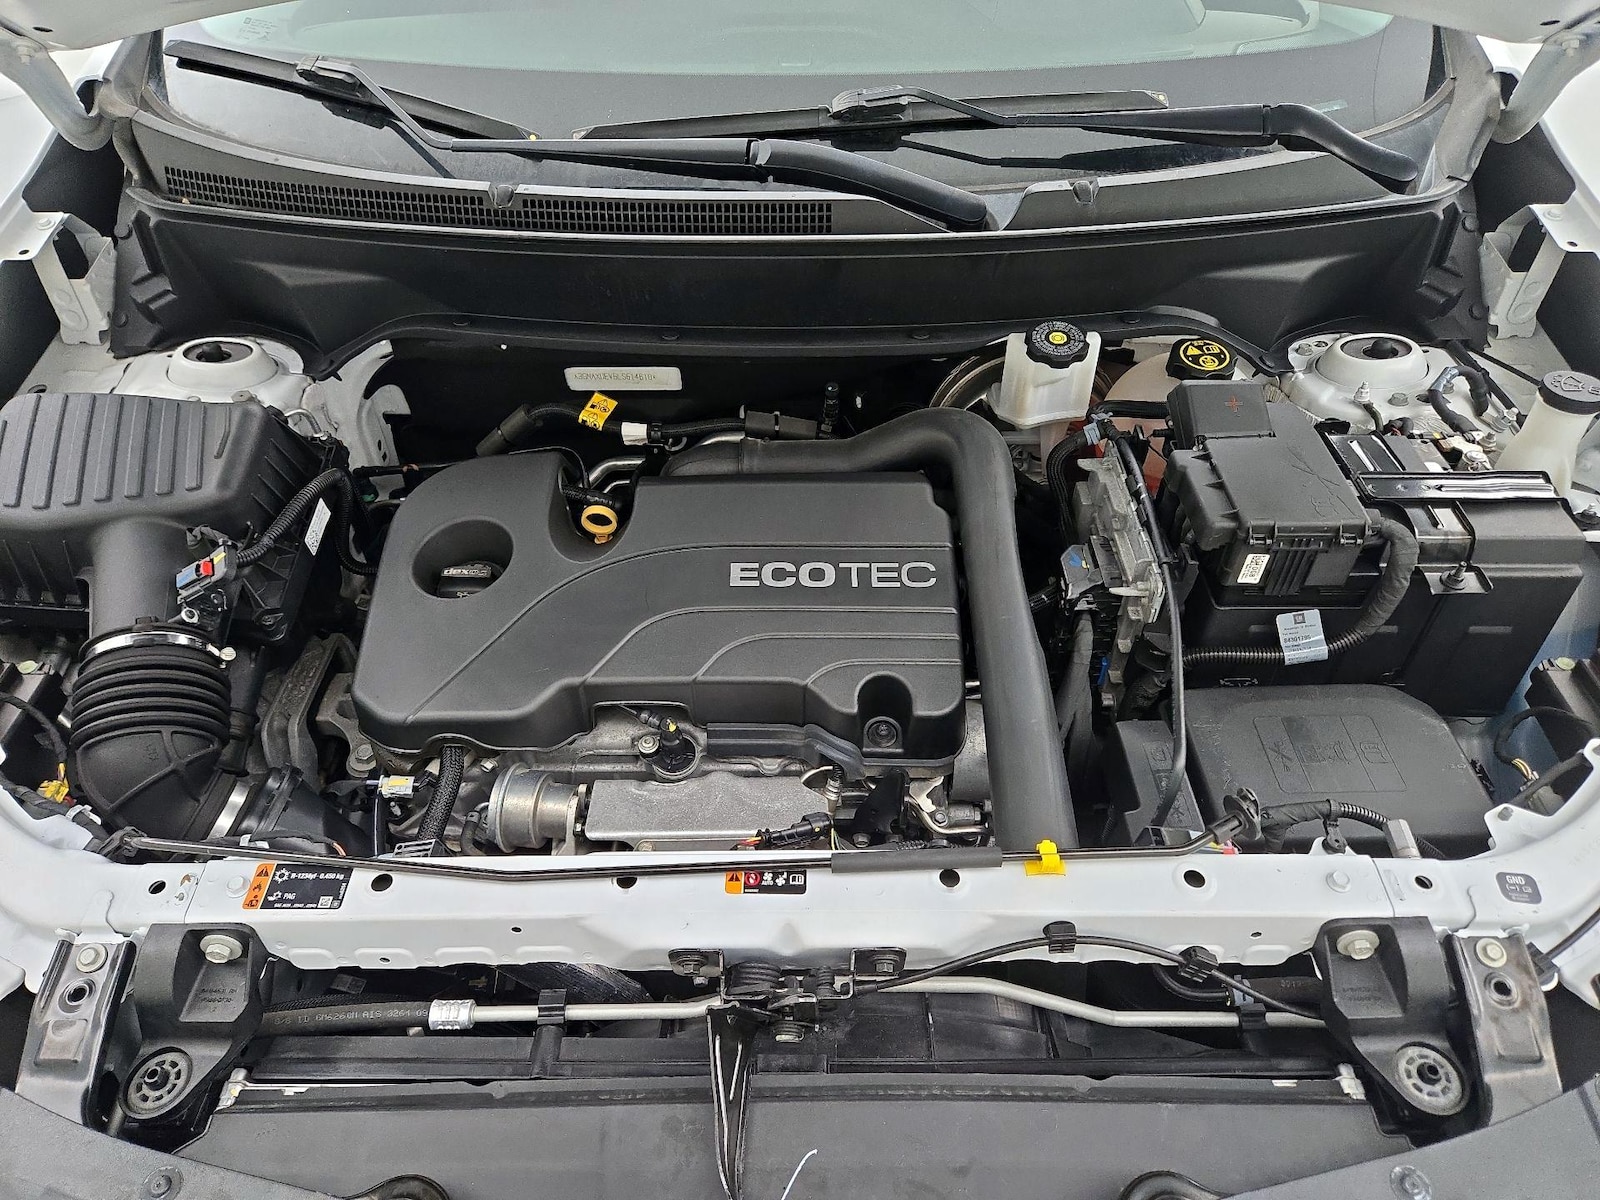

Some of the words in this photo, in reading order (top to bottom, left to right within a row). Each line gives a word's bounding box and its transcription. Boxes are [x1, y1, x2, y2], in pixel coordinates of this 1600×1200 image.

[729, 561, 937, 588] ECOTEC
[1506, 875, 1525, 885] GND
[283, 892, 296, 900] PAG
